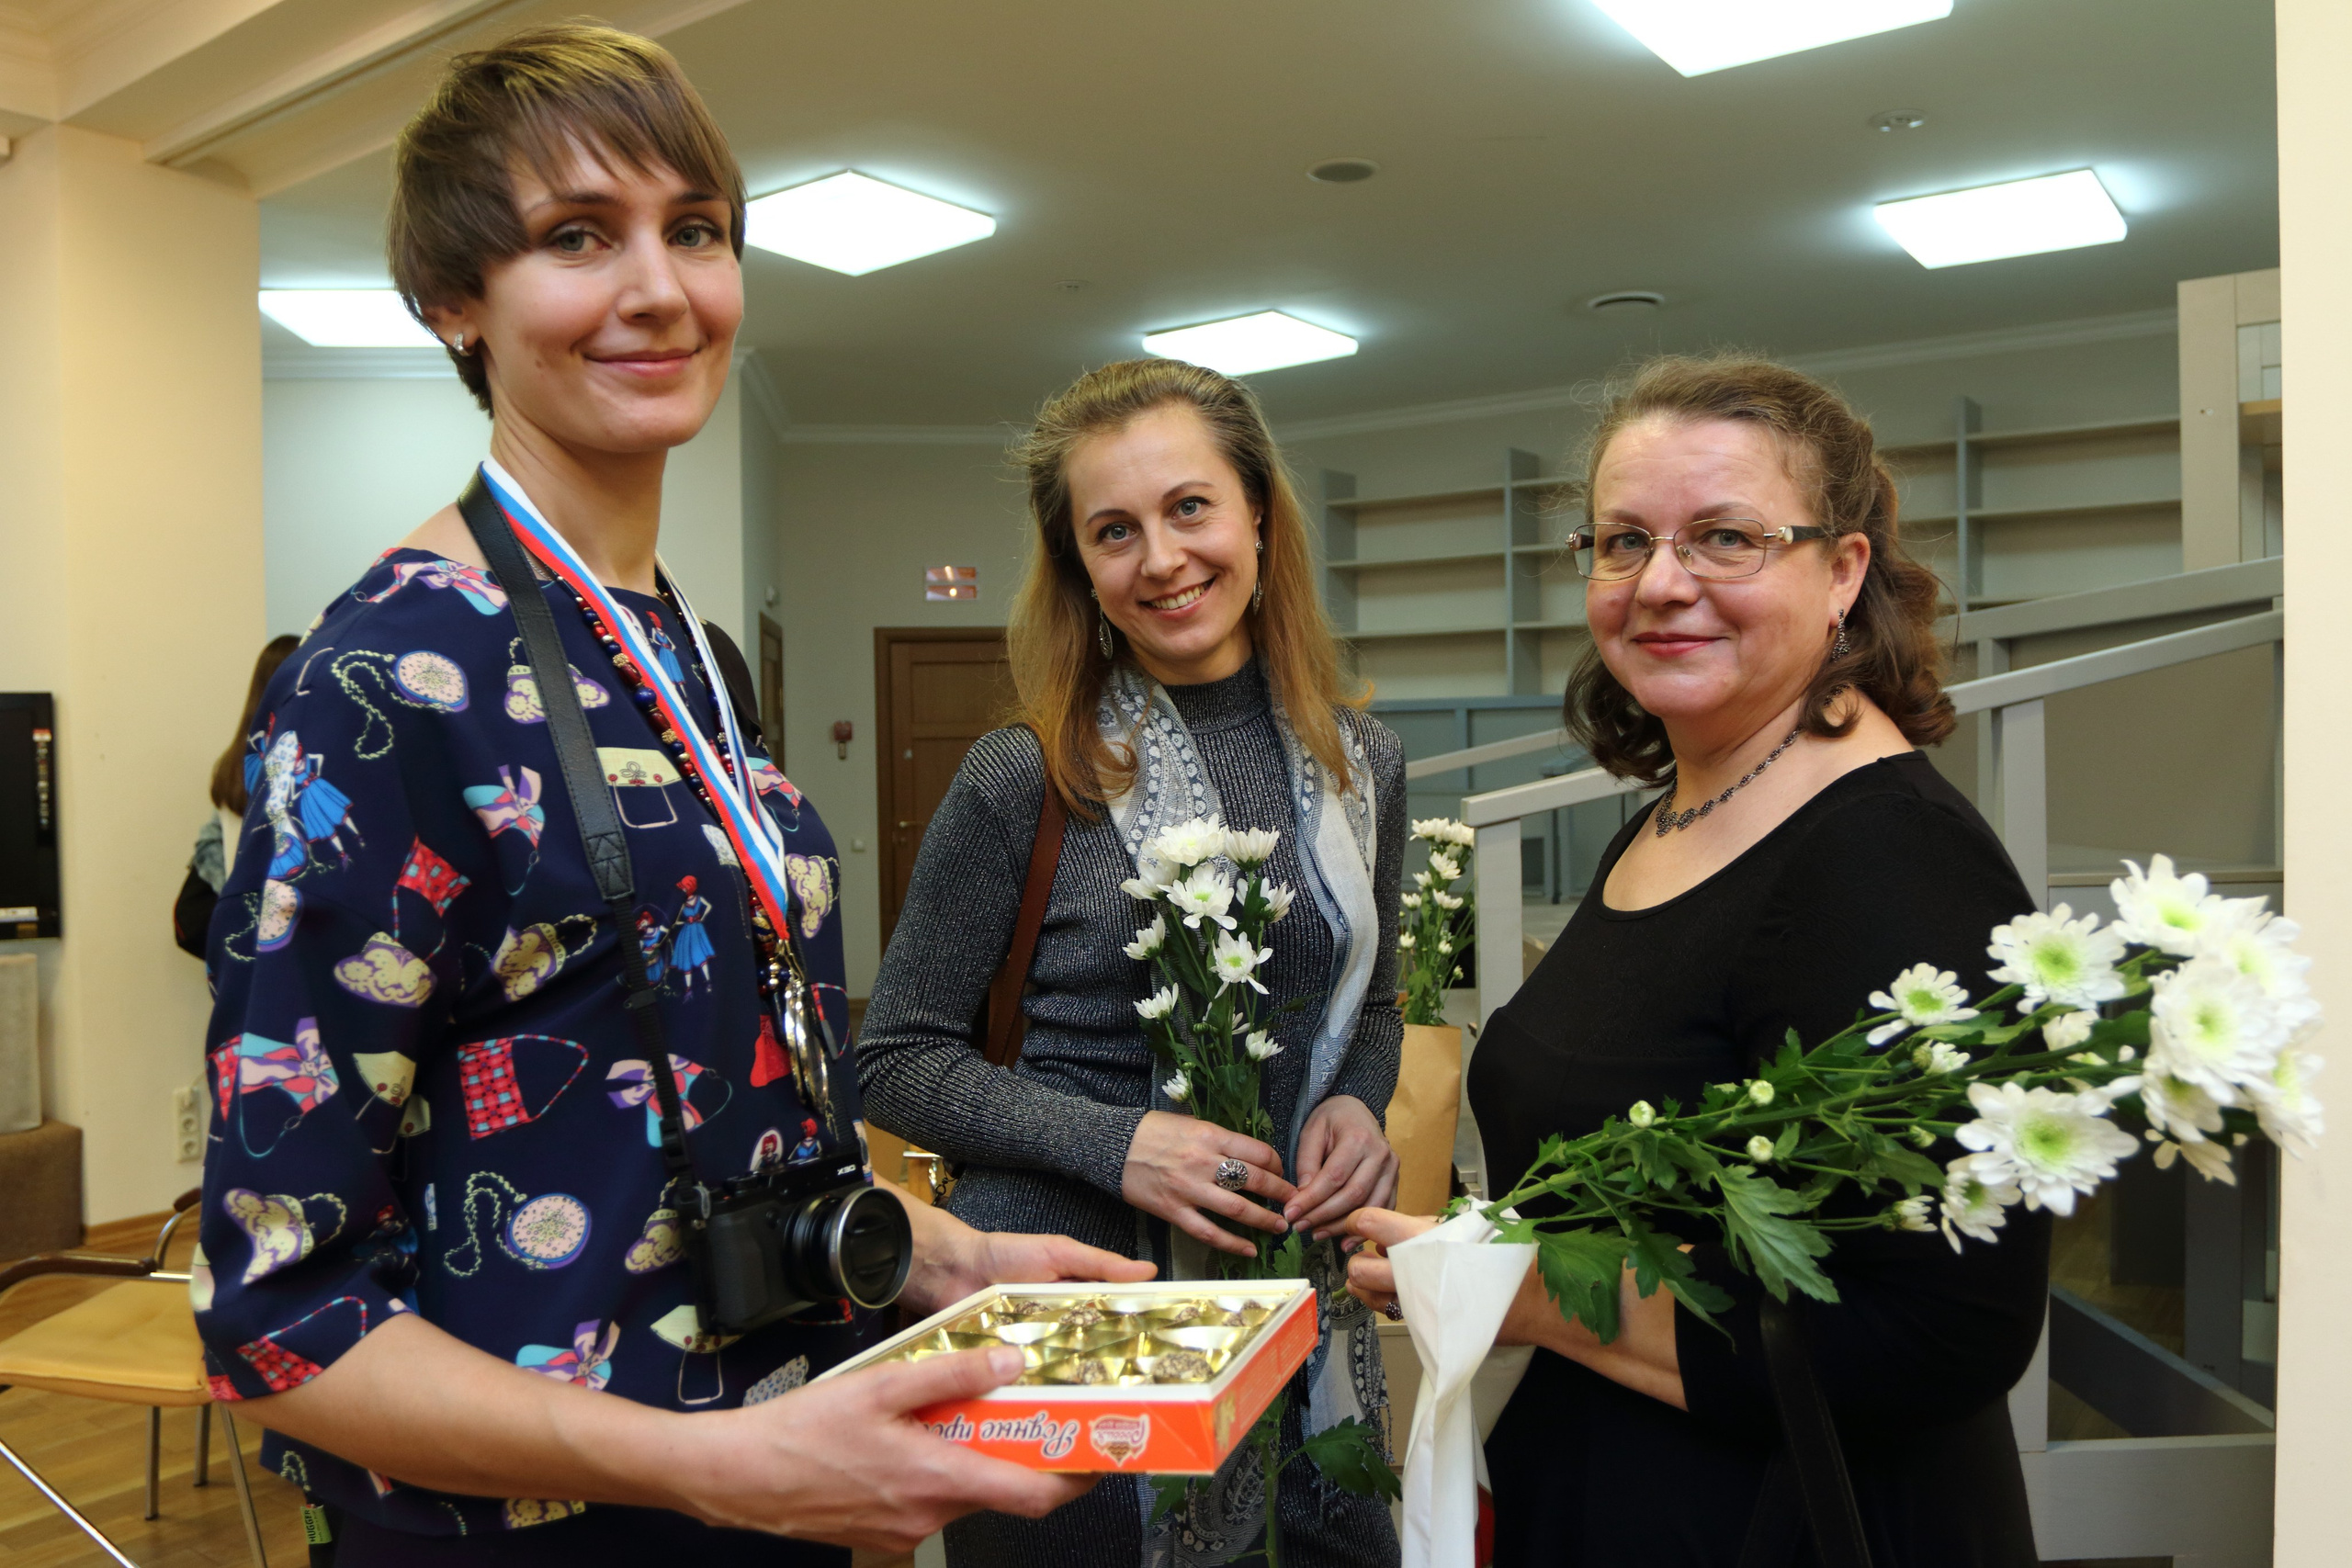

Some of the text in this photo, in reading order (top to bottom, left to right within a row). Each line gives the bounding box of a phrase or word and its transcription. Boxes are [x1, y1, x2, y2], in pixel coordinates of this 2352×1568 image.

[837, 1164, 856, 1176] X30
[923, 1412, 1080, 1458] Родные про
[304, 1509, 316, 1542] HUGGER
